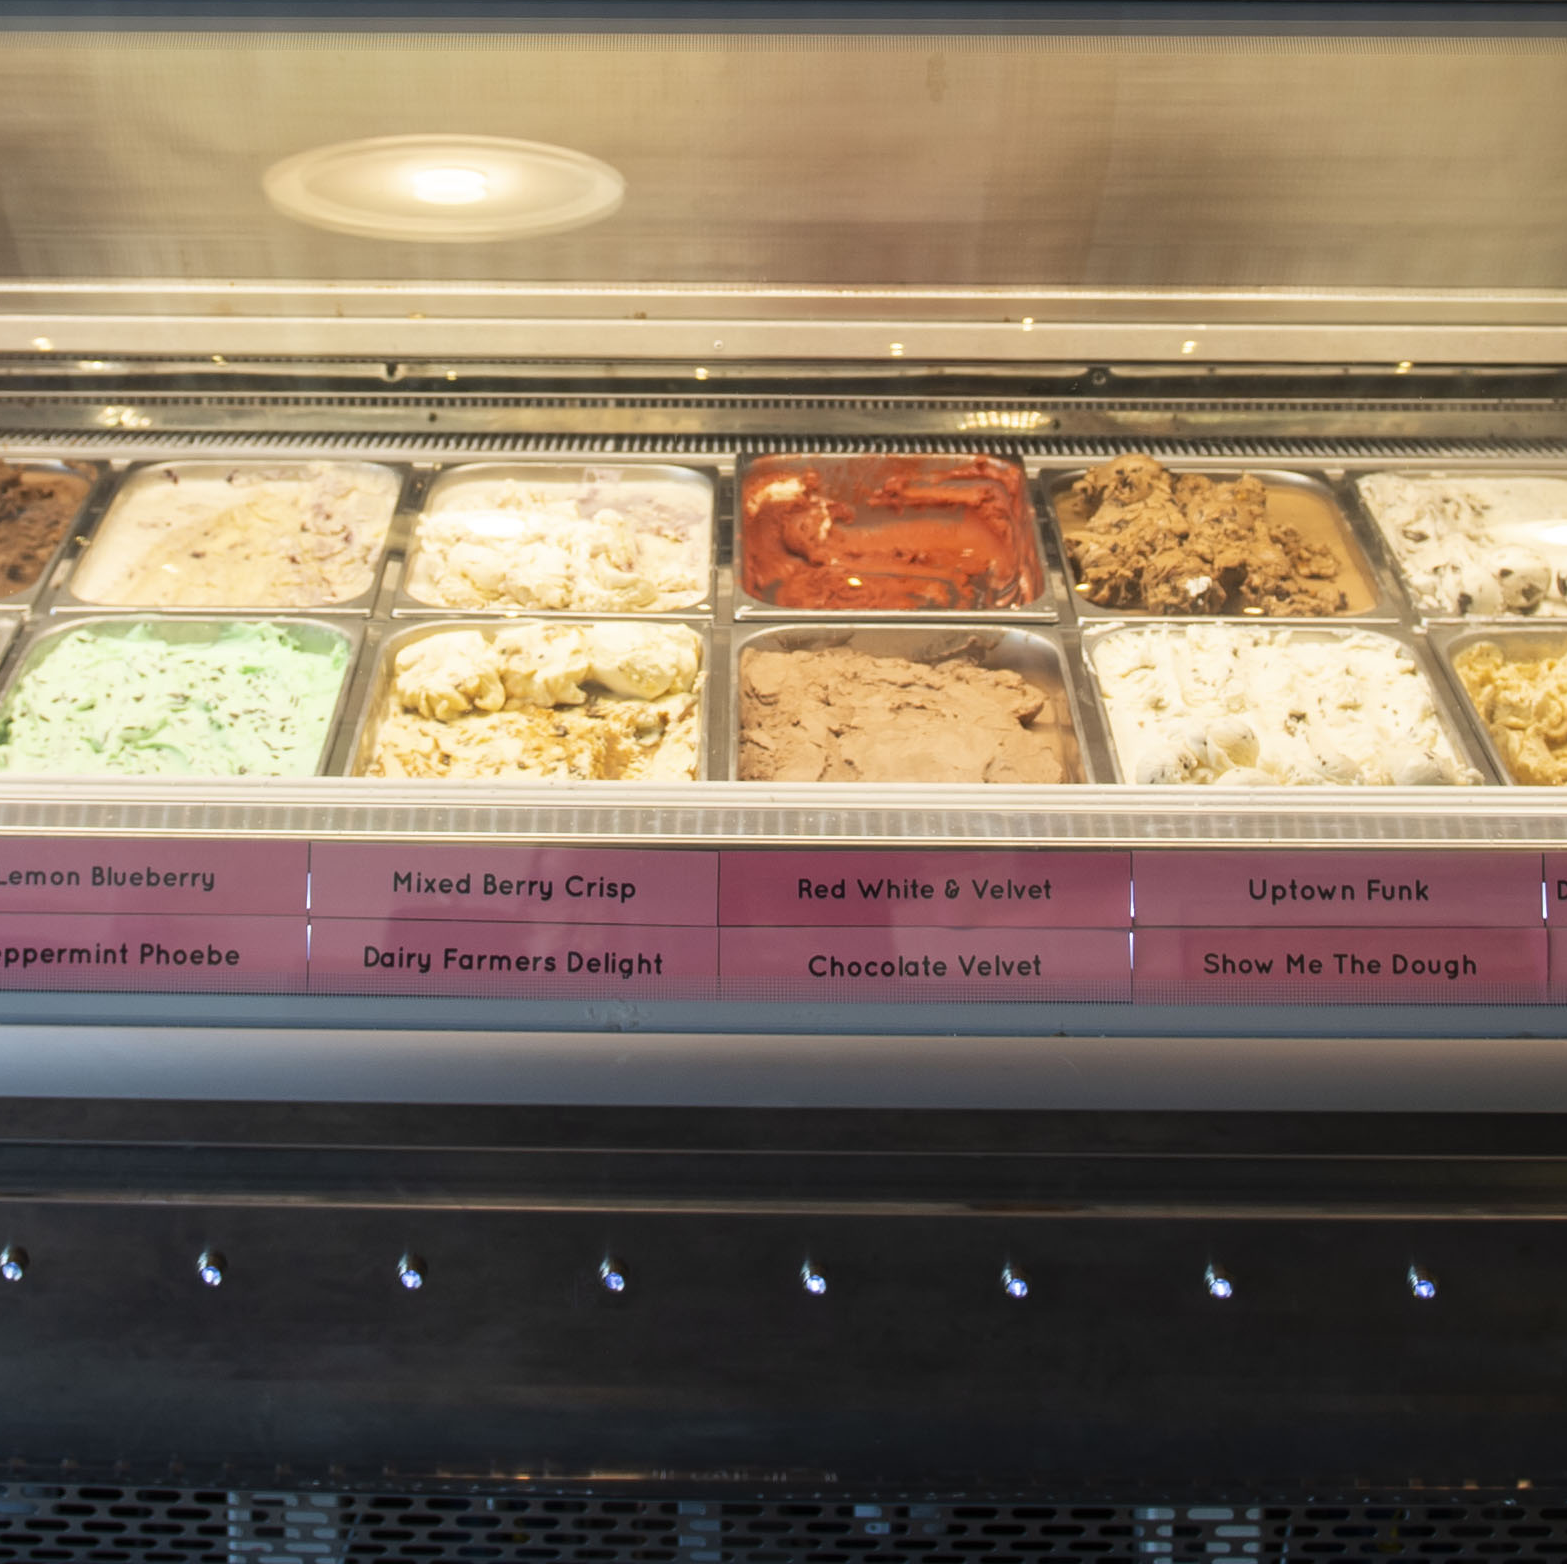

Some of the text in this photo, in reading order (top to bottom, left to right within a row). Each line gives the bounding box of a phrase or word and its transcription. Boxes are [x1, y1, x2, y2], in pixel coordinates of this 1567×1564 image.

[92, 866, 214, 891] Blueberry
[394, 871, 635, 903] Mixed Berry Crisp
[799, 879, 1051, 899] Red White & Velvet
[1249, 879, 1428, 905] Uptown Funk
[140, 943, 239, 965] Phoebe
[364, 946, 662, 979] Dairy Farmers Delight
[809, 955, 1041, 977] Chocolate Velvet
[1204, 953, 1476, 980] Show Me The Dough
